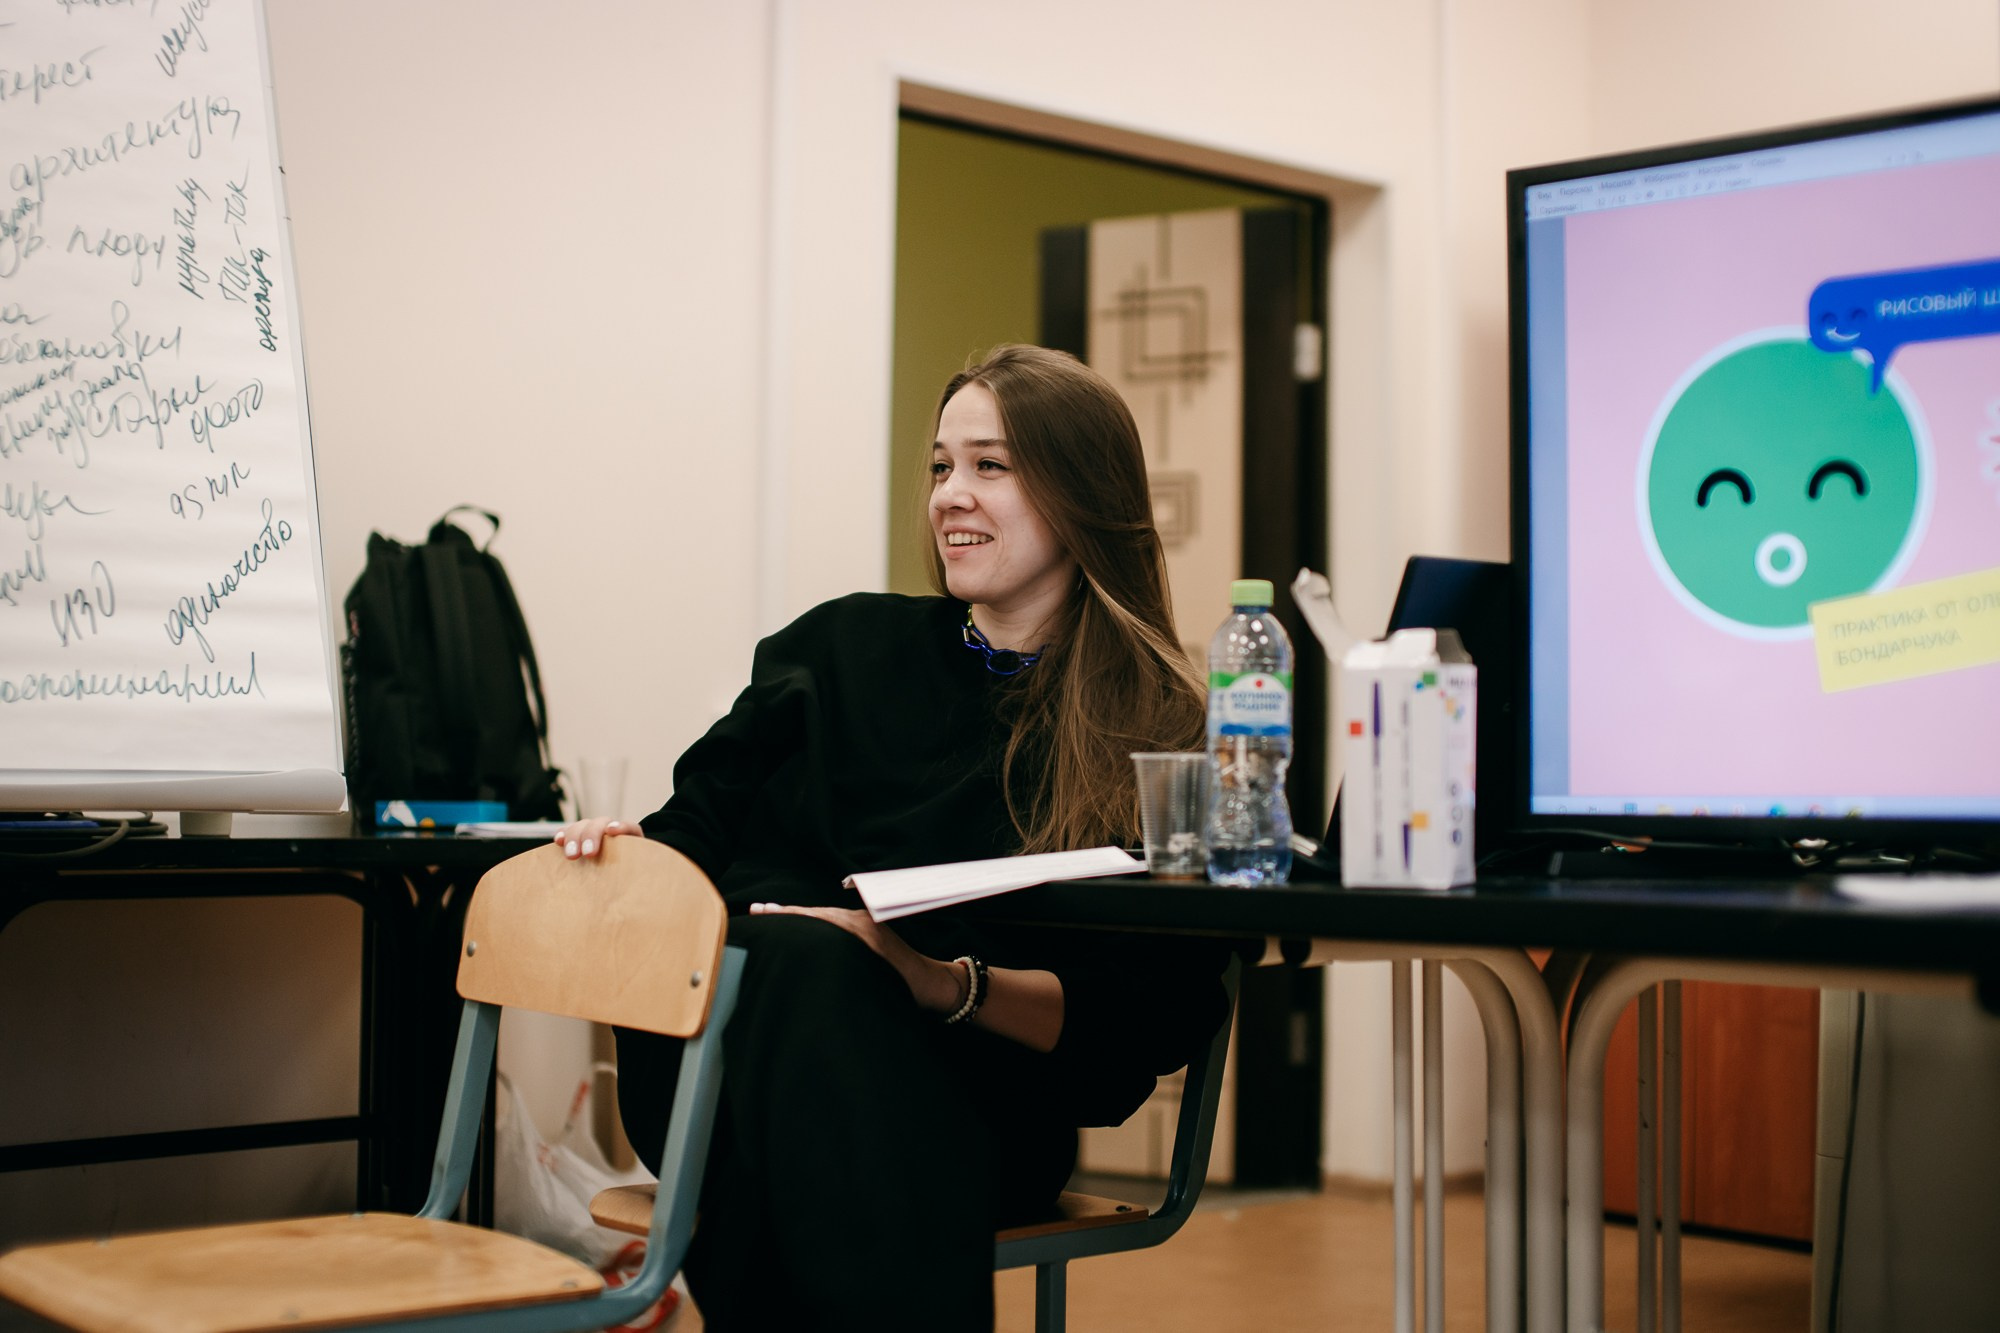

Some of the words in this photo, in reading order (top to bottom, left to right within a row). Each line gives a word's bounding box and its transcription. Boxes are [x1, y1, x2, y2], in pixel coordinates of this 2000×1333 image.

[1880, 287, 1977, 317] РИСОВЫЙ
[1834, 608, 1928, 638] ПРАКТИКА
[1936, 602, 1958, 618] ОТ
[1838, 630, 1961, 666] БОНДАРЧУКА
